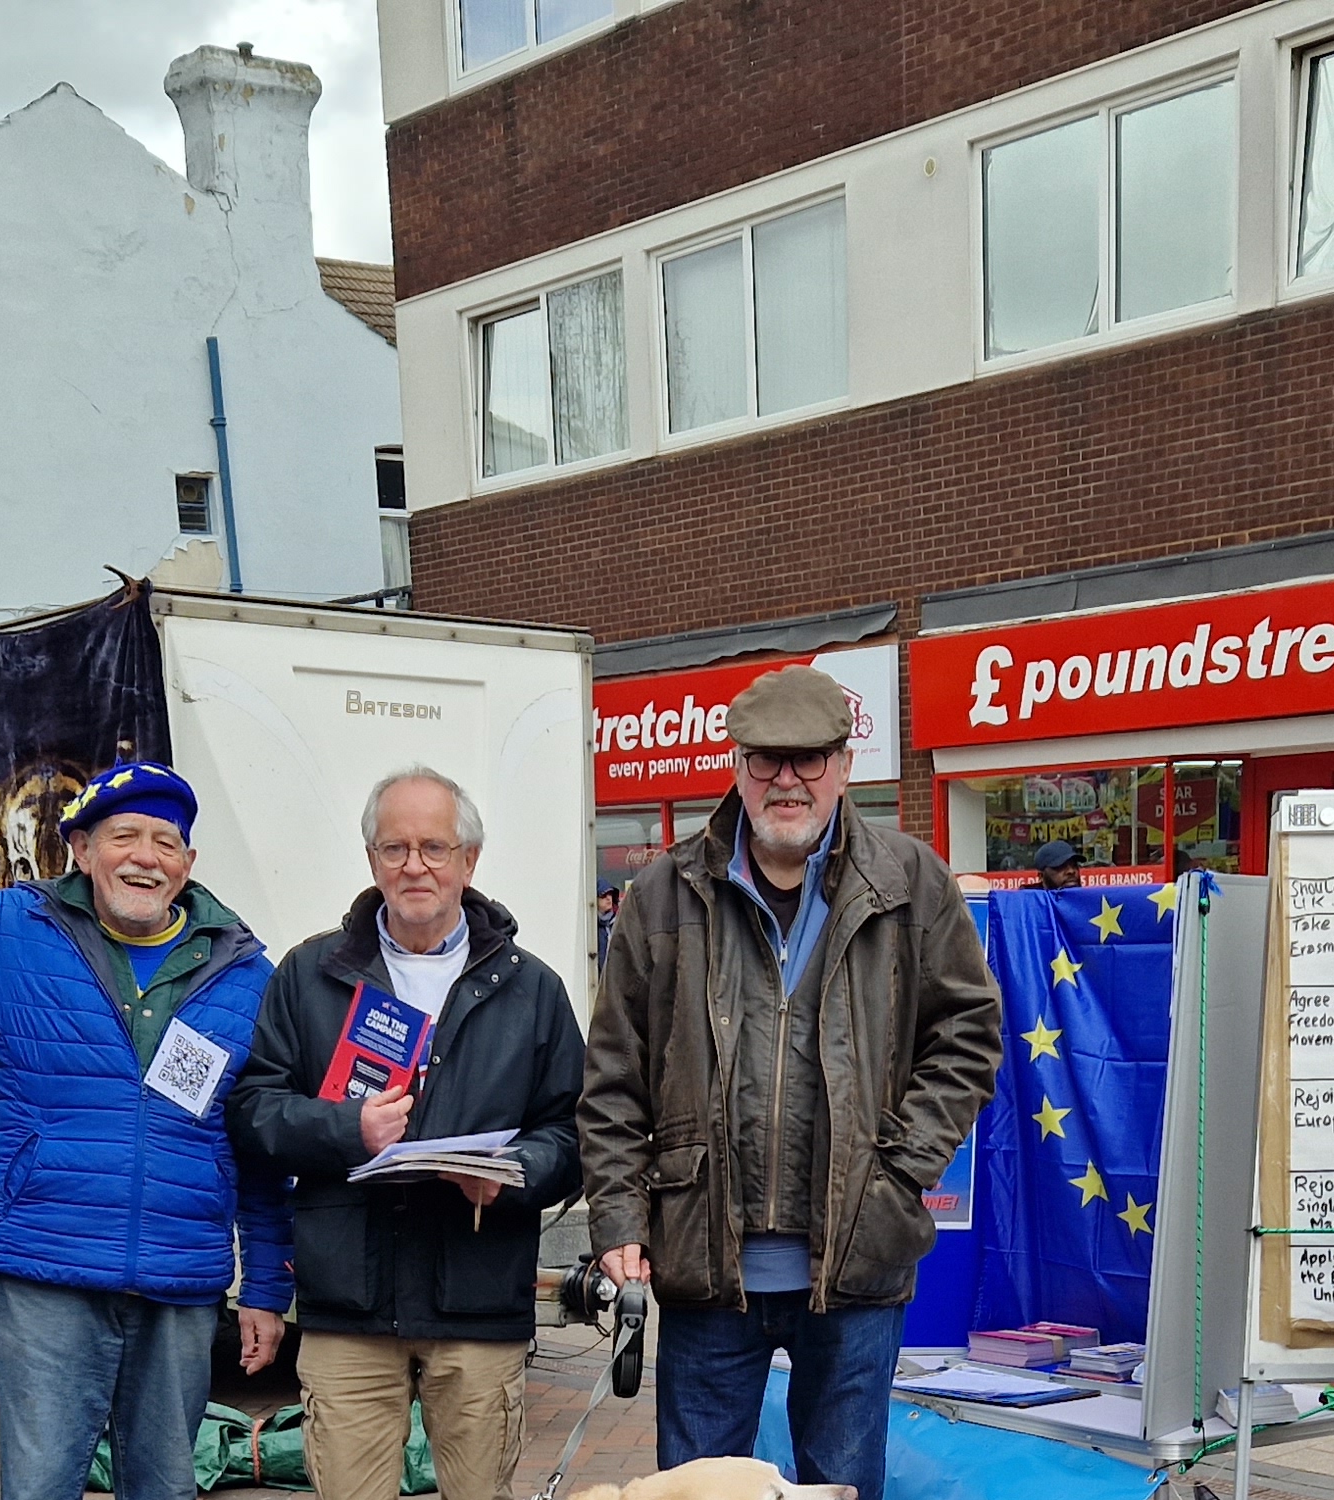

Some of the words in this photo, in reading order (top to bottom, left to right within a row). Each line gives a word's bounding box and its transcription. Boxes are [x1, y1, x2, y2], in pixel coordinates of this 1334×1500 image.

[970, 645, 1012, 727] £
[593, 695, 729, 754] tretche
[608, 760, 644, 780] every
[648, 755, 691, 779] penny
[1160, 785, 1192, 800] SAR
[1155, 803, 1197, 817] DALS
[1088, 874, 1107, 887] BIG
[1110, 872, 1153, 886] BRANDS
[1293, 896, 1324, 910] UK
[1292, 916, 1330, 932] Take
[1289, 990, 1330, 1012] Agree
[365, 1017, 407, 1043] CAMPAIGN
[367, 1008, 391, 1024] JOIN
[391, 1018, 409, 1034] THE
[1301, 1270, 1325, 1284] the
